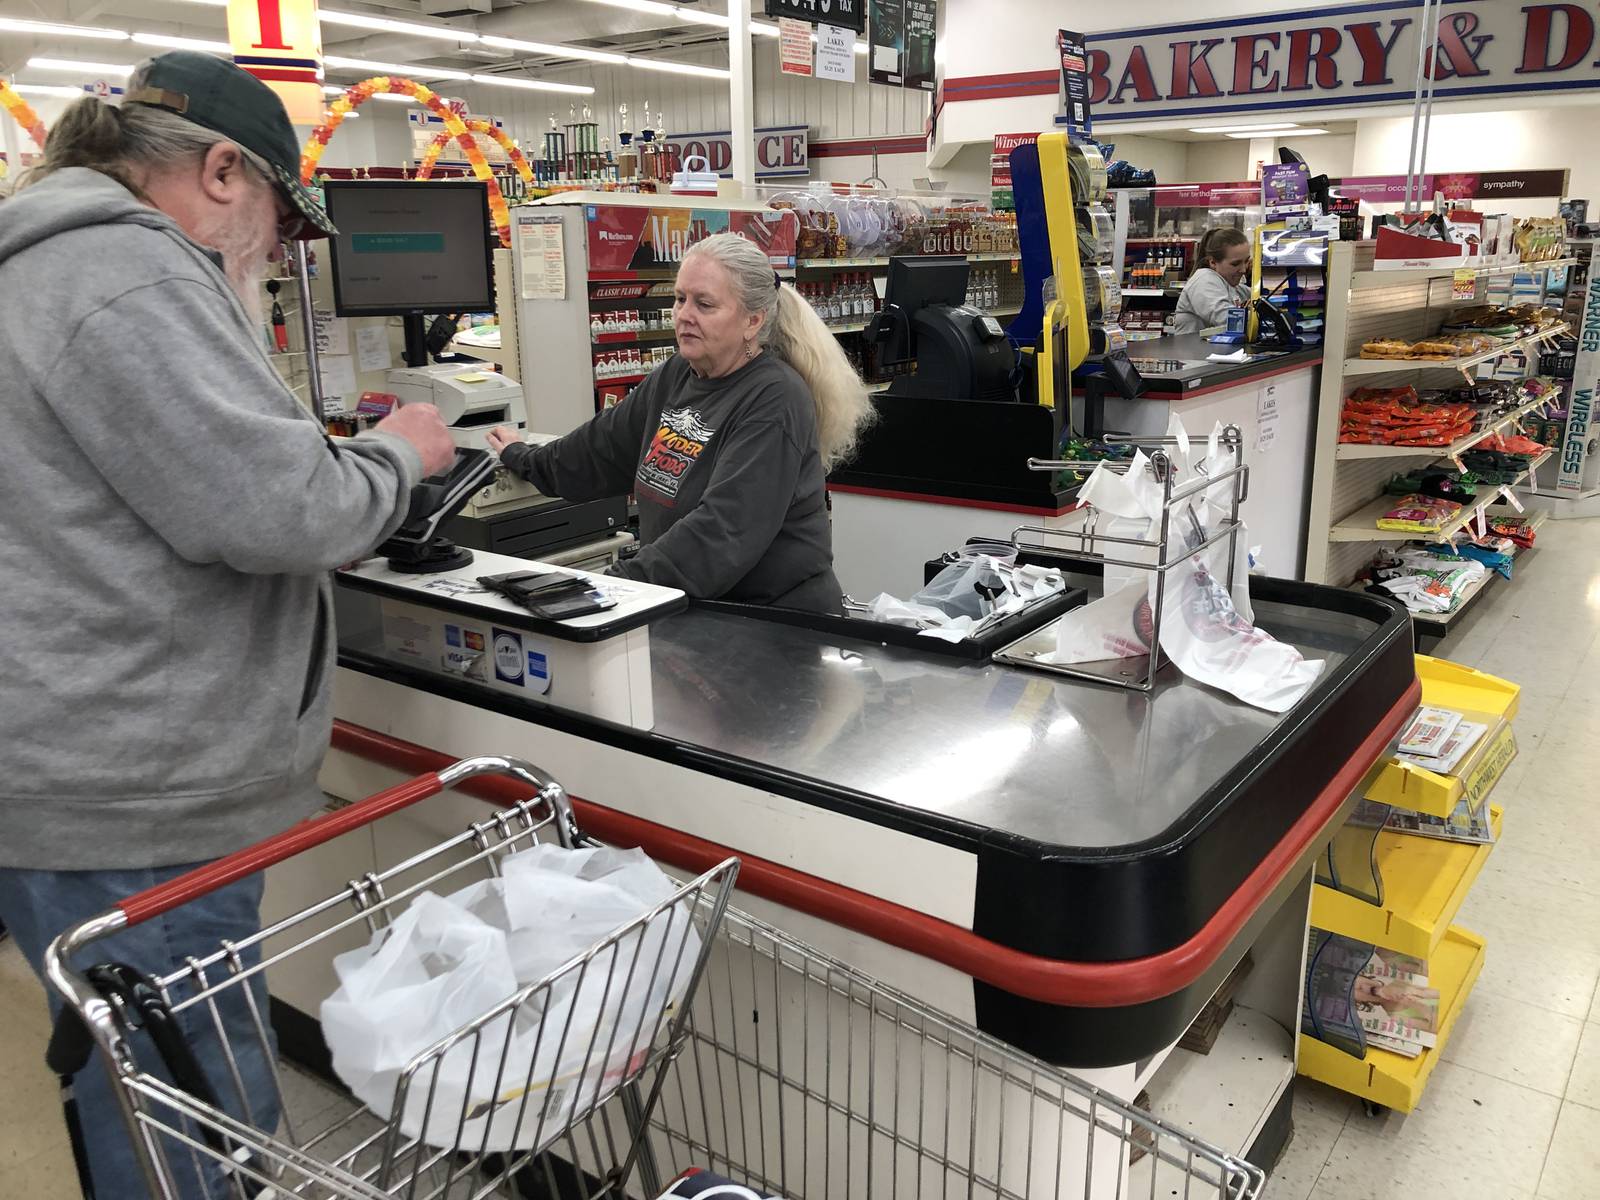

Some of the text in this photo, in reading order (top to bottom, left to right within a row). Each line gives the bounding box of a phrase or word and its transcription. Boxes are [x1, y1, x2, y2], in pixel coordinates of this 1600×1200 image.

[1085, 19, 1412, 105] BAKERY
[1424, 12, 1493, 81] &
[1515, 4, 1600, 73] D
[995, 136, 1035, 149] Winston
[638, 134, 804, 174] PRODCE
[1483, 180, 1525, 189] sympathy
[597, 286, 643, 297] CLASSIC FLAVOR
[1563, 388, 1592, 475] WIRELESS
[448, 652, 464, 662] VISA
